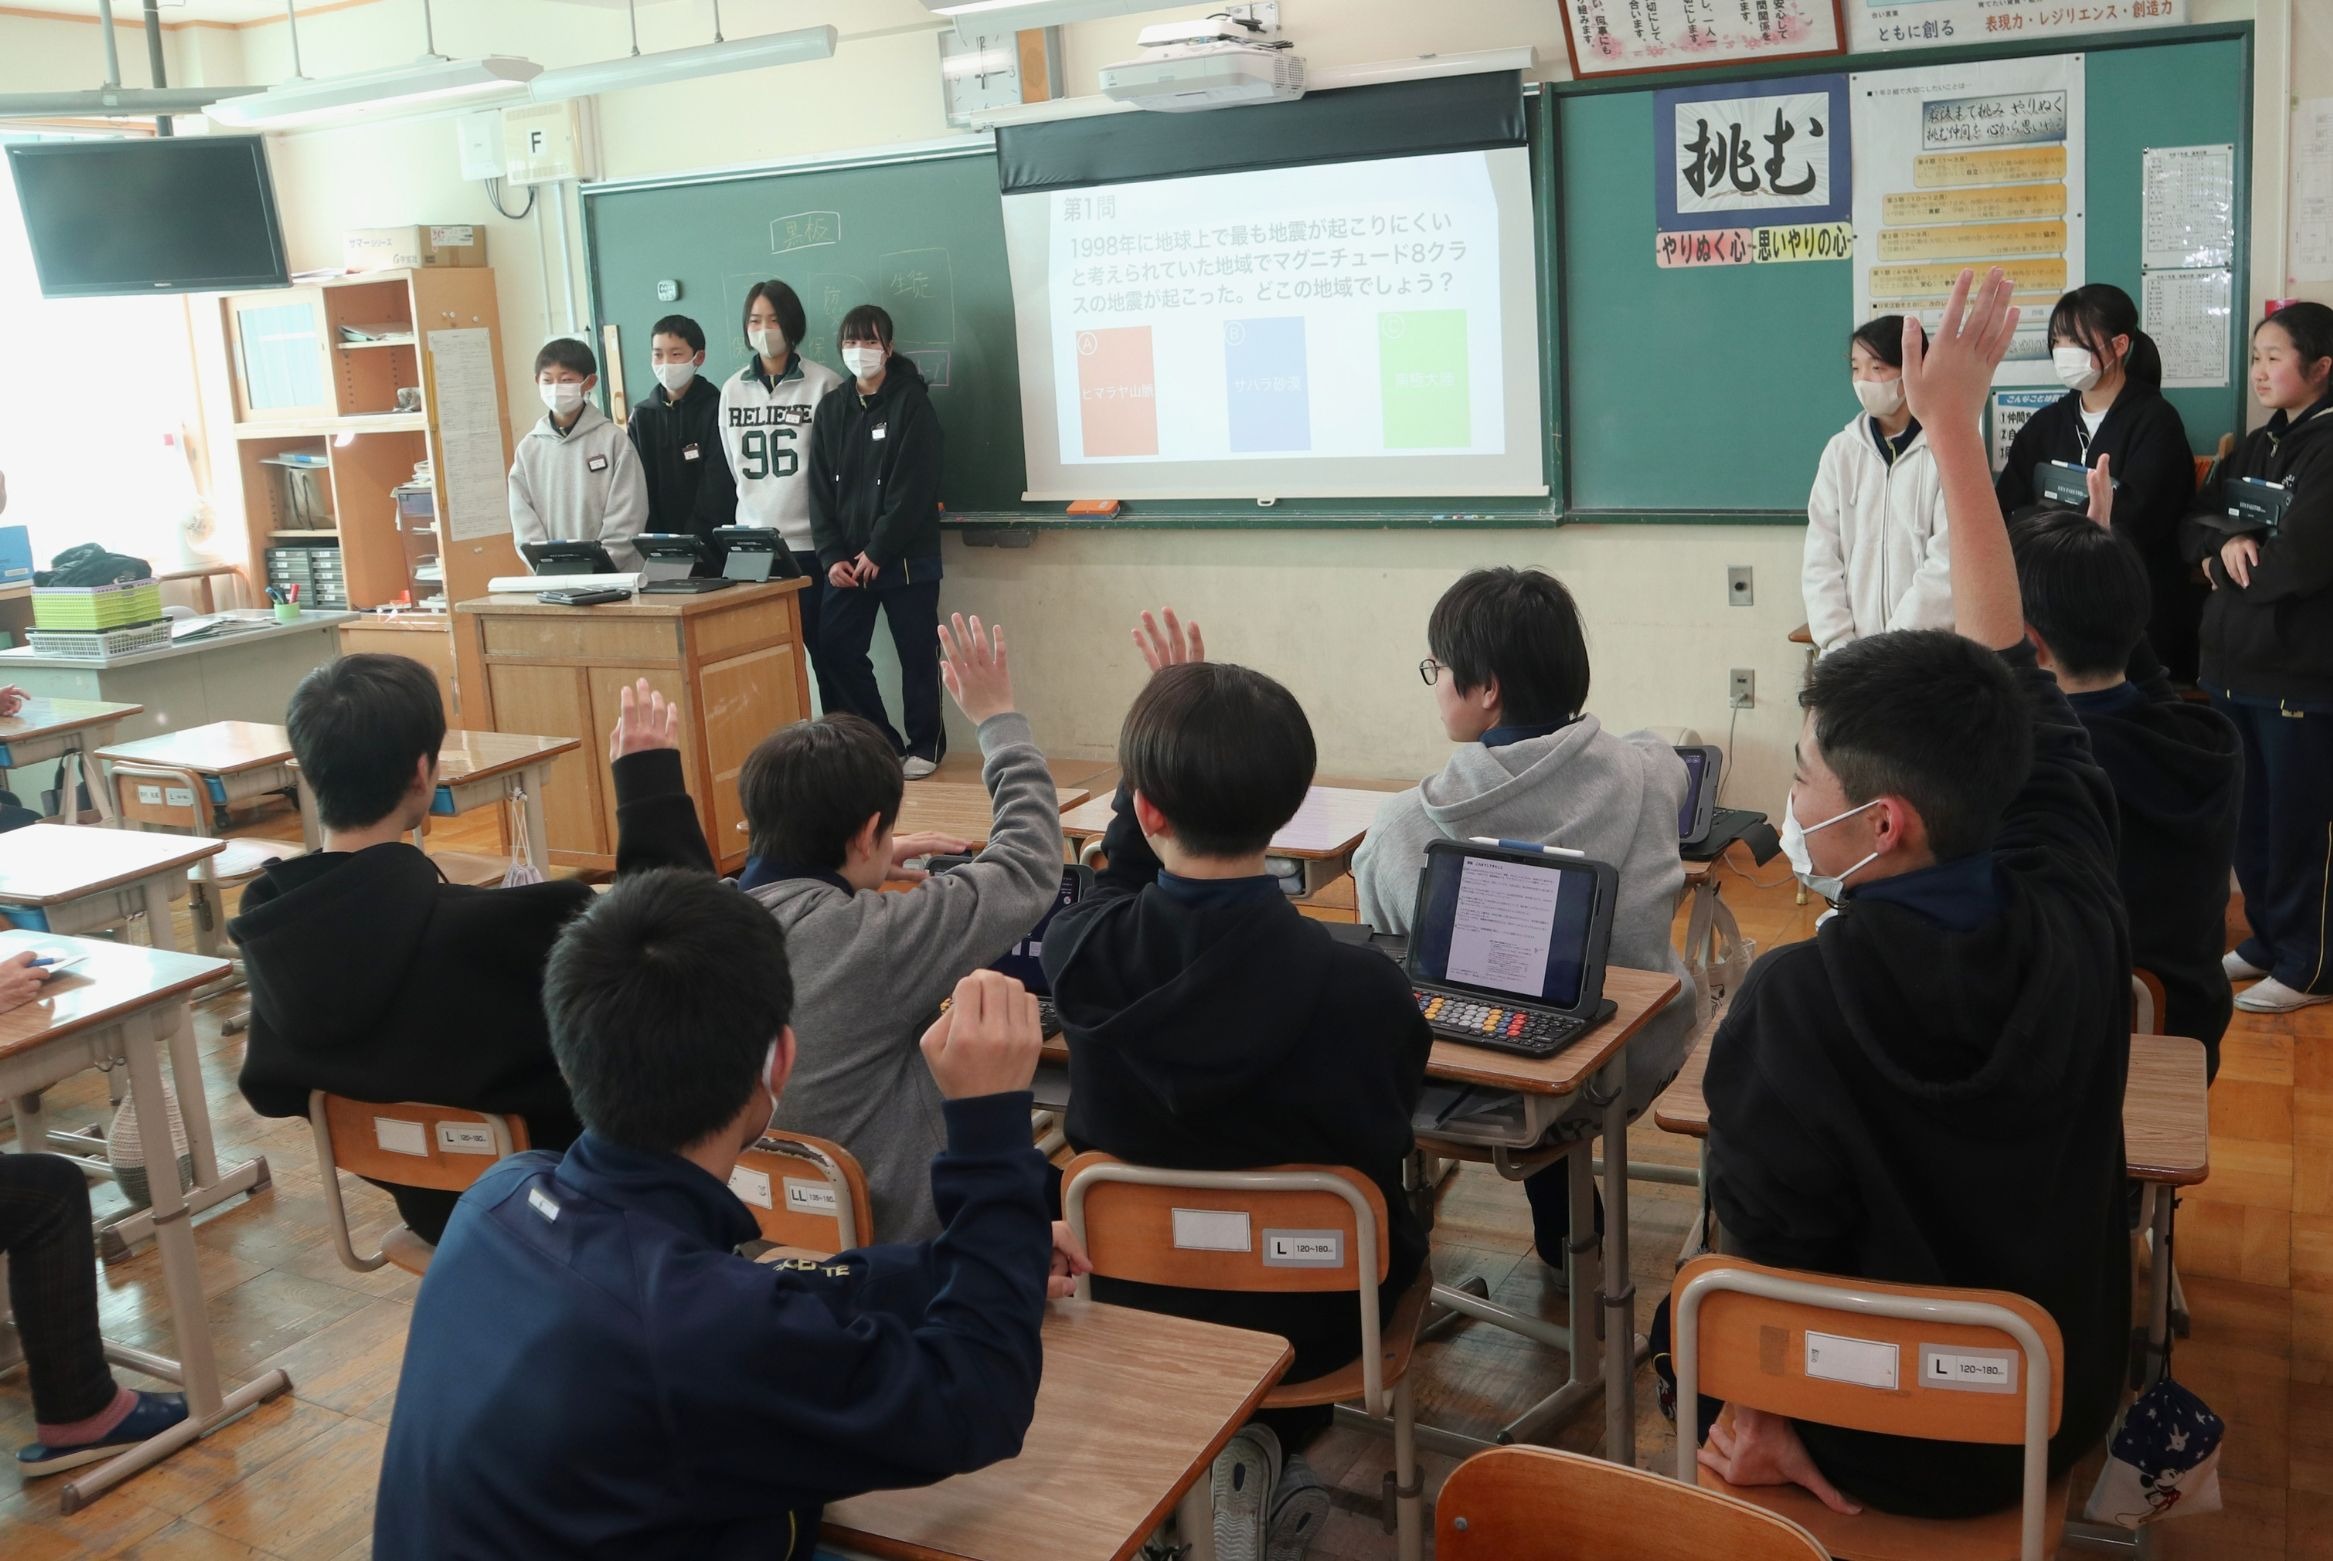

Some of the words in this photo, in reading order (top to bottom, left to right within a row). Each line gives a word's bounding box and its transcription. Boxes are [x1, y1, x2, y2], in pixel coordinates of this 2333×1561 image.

[1879, 19, 1955, 42] ともに創る
[1985, 0, 2173, 32] 表現力・レジリエンス・創造力
[531, 131, 541, 153] F
[1682, 107, 1824, 198] 挑む
[1063, 194, 1117, 223] 第1問
[1070, 211, 1452, 260] 1998年に地球上で最も地震が起こりにくい
[1662, 231, 1746, 264] やりぬく心
[1758, 225, 1848, 261] 思いやりの心
[1071, 240, 1468, 288] と考えられていた地域でマグニチュード8クラ
[1072, 271, 1456, 315] スの地震が起こった。どこの地域でしょう？
[742, 428, 799, 479] 96
[445, 1131, 454, 1143] L
[791, 1189, 807, 1202] LL
[1277, 1241, 1287, 1255] L
[1936, 1359, 1948, 1375] L
